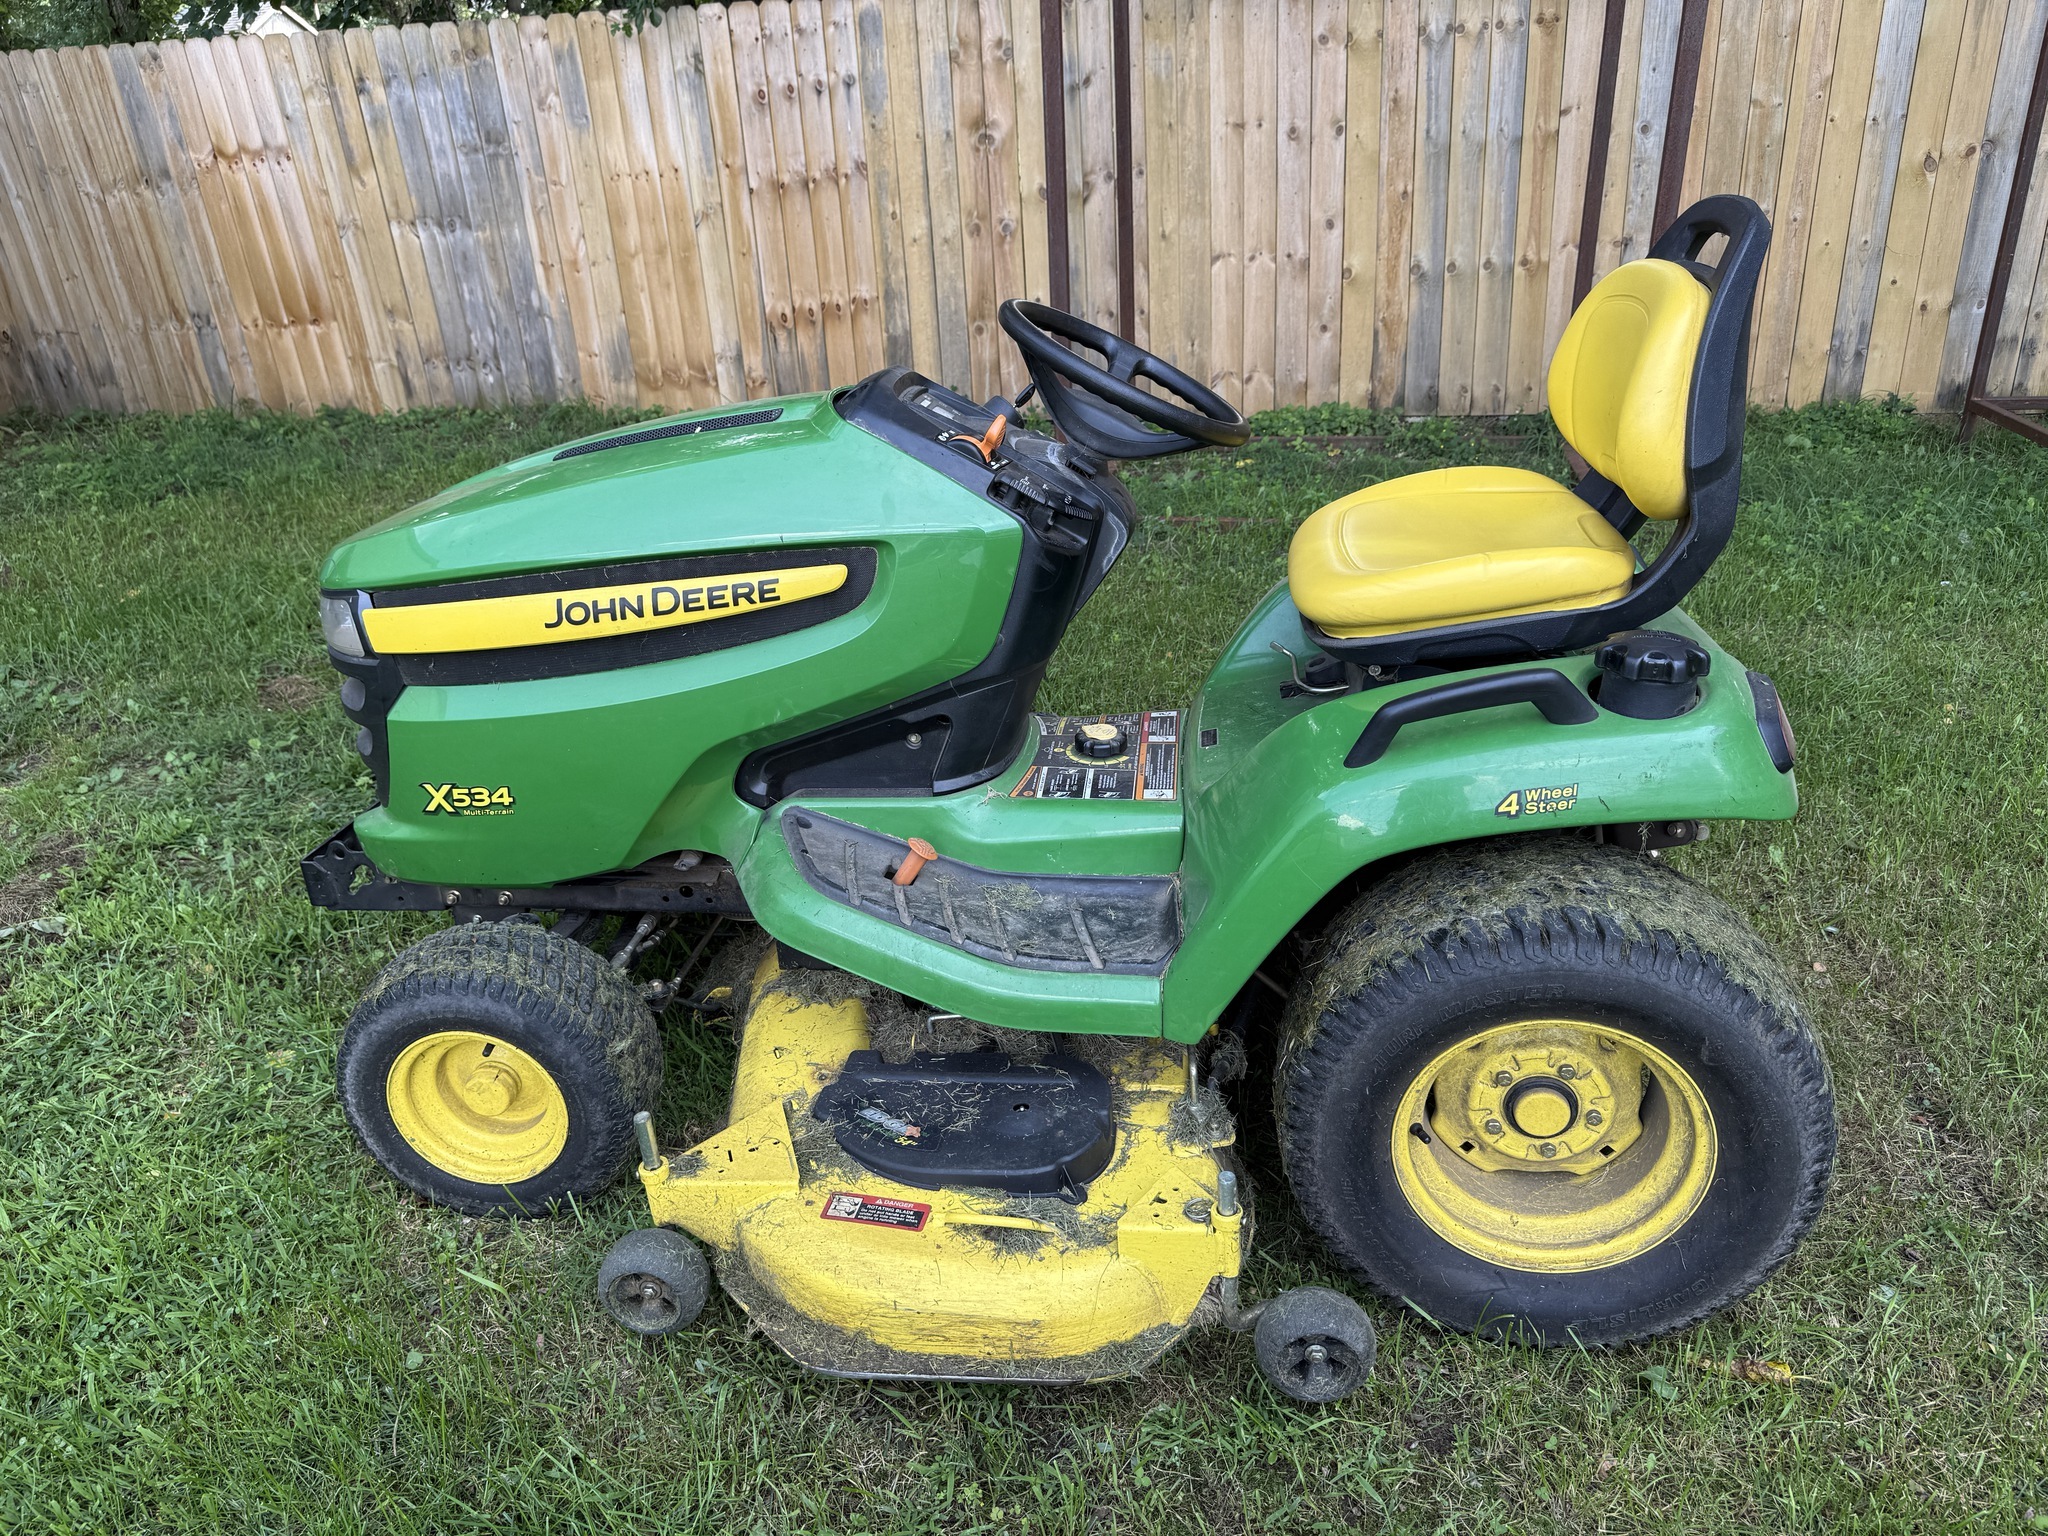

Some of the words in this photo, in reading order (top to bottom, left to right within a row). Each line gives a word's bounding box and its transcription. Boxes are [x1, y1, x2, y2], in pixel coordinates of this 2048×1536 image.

[544, 594, 645, 629] JOHN
[651, 577, 781, 617] DEERE
[420, 783, 515, 814] X534
[1496, 791, 1520, 816] 4
[1525, 783, 1578, 802] Wheel
[463, 808, 515, 816] Multi-Terrain
[1525, 799, 1576, 815] Steer
[1371, 1017, 1425, 1067] TURF
[1438, 983, 1566, 1022] MASTER
[867, 1204, 894, 1213] ROTATING
[883, 1199, 914, 1208] DANGER
[1572, 1278, 1710, 1332] CARLISLE
